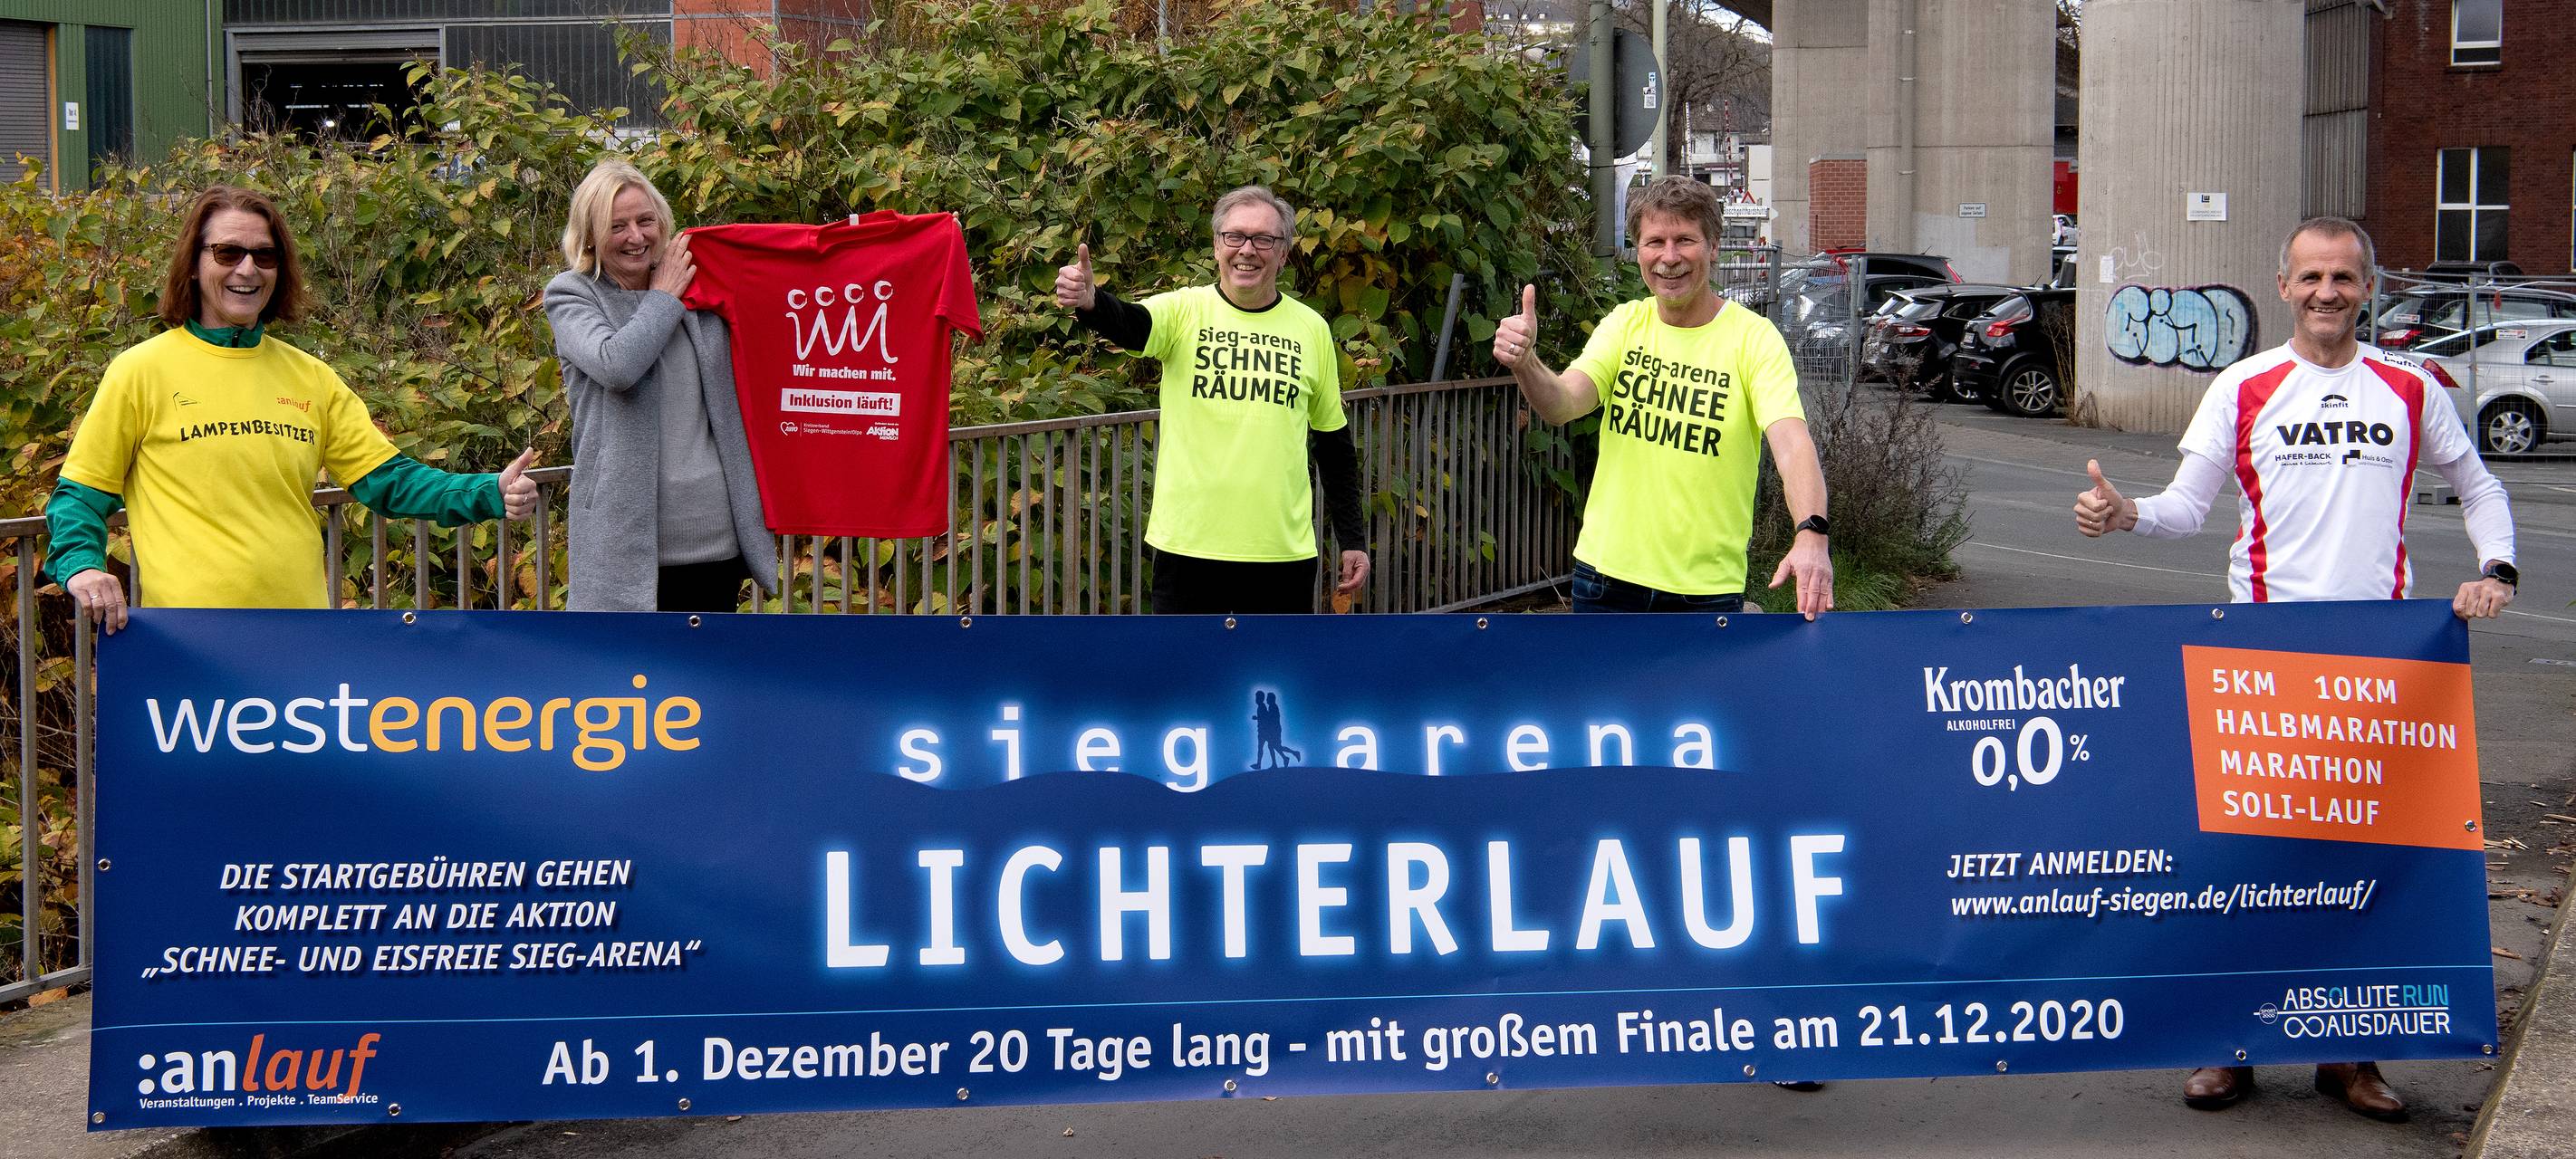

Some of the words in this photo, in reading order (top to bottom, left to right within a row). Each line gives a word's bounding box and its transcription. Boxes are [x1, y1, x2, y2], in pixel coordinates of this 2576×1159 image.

[1198, 327, 1302, 354] sieg-arena
[793, 364, 815, 377] Wir
[819, 367, 867, 379] machen
[870, 368, 896, 381] mit.
[1195, 346, 1302, 380] SCHNEE
[1624, 346, 1731, 388] sieg-arena
[790, 394, 851, 409] Inklusion
[857, 396, 893, 411] läuft!
[1192, 370, 1299, 408] RÄUMER
[1613, 370, 1728, 422] SCHNEE
[180, 420, 314, 445] LAMPENBESITZER
[1609, 402, 1722, 456] RÄUMER
[2276, 421, 2394, 445] VATRO
[2274, 453, 2331, 461] HAFER-BACK
[1924, 664, 2125, 712] Krombacher
[2212, 668, 2276, 696] 5KM
[2314, 675, 2397, 704] 10KM
[146, 674, 702, 771] westenergie
[1946, 718, 2016, 731] ALKOHOLFREI
[2216, 708, 2456, 750] HALBMARATHON
[1335, 722, 1716, 776] arena
[2220, 749, 2383, 785] MARATHON
[2223, 790, 2379, 826] SOLI-LAUF
[219, 864, 274, 889] DIE
[280, 856, 525, 890] STARTGEBÜHREN
[536, 859, 631, 887] GEHEN
[1946, 853, 2022, 878] JETZT
[2028, 848, 2174, 876] ANMELDEN:
[235, 904, 388, 931] KOMPLETT
[393, 904, 437, 930] AN
[448, 903, 498, 929] DIE
[505, 901, 617, 928] AKTION
[826, 834, 1845, 968] LICHTERLAUF
[1951, 879, 2378, 918] www.anlauf-siegen.de/lichterlauf/
[298, 945, 363, 972] UND
[372, 943, 503, 972] EISFREIE
[542, 1039, 610, 1085] Ab
[634, 1039, 679, 1083] 1.
[703, 1031, 950, 1080] Dezember
[969, 1030, 1029, 1074] 20
[1046, 1028, 1152, 1081] Tage
[1172, 1022, 1271, 1077] lang
[1326, 1016, 1407, 1062] mit
[1423, 1012, 1598, 1071] großem
[1617, 1007, 1755, 1054] Finale
[1773, 1016, 1839, 1049] am
[1858, 998, 2124, 1047] 21.12.2020
[139, 1032, 381, 1102] :anlauf
[139, 1097, 235, 1109] Veranstaltungen
[247, 1094, 297, 1108] Projekte
[307, 1092, 379, 1106] TeamService
